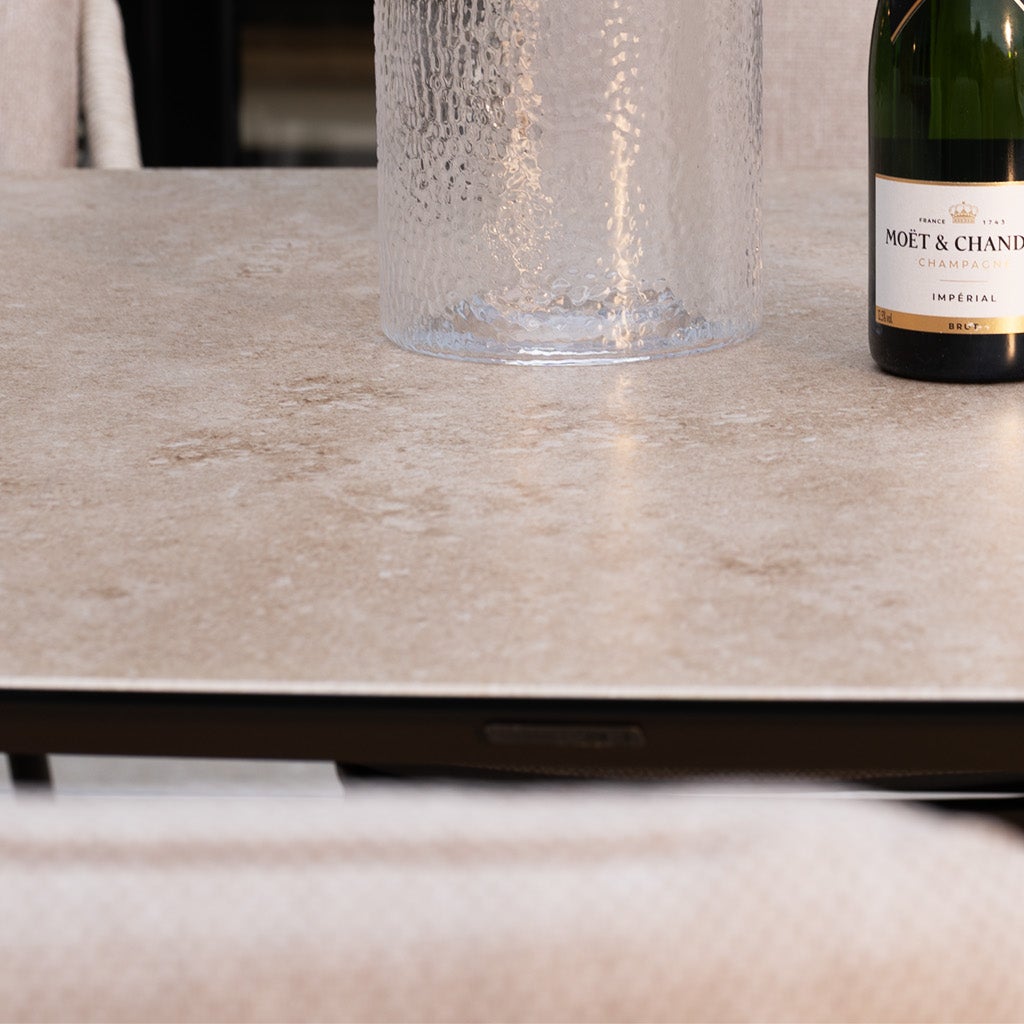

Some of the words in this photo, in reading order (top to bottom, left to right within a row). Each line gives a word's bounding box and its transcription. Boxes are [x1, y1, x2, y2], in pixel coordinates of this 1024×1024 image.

[919, 217, 946, 225] FRANCE
[885, 228, 931, 251] MOËT
[935, 234, 949, 251] &
[932, 292, 997, 303] IMPÉRIAL
[948, 322, 979, 330] BRUT
